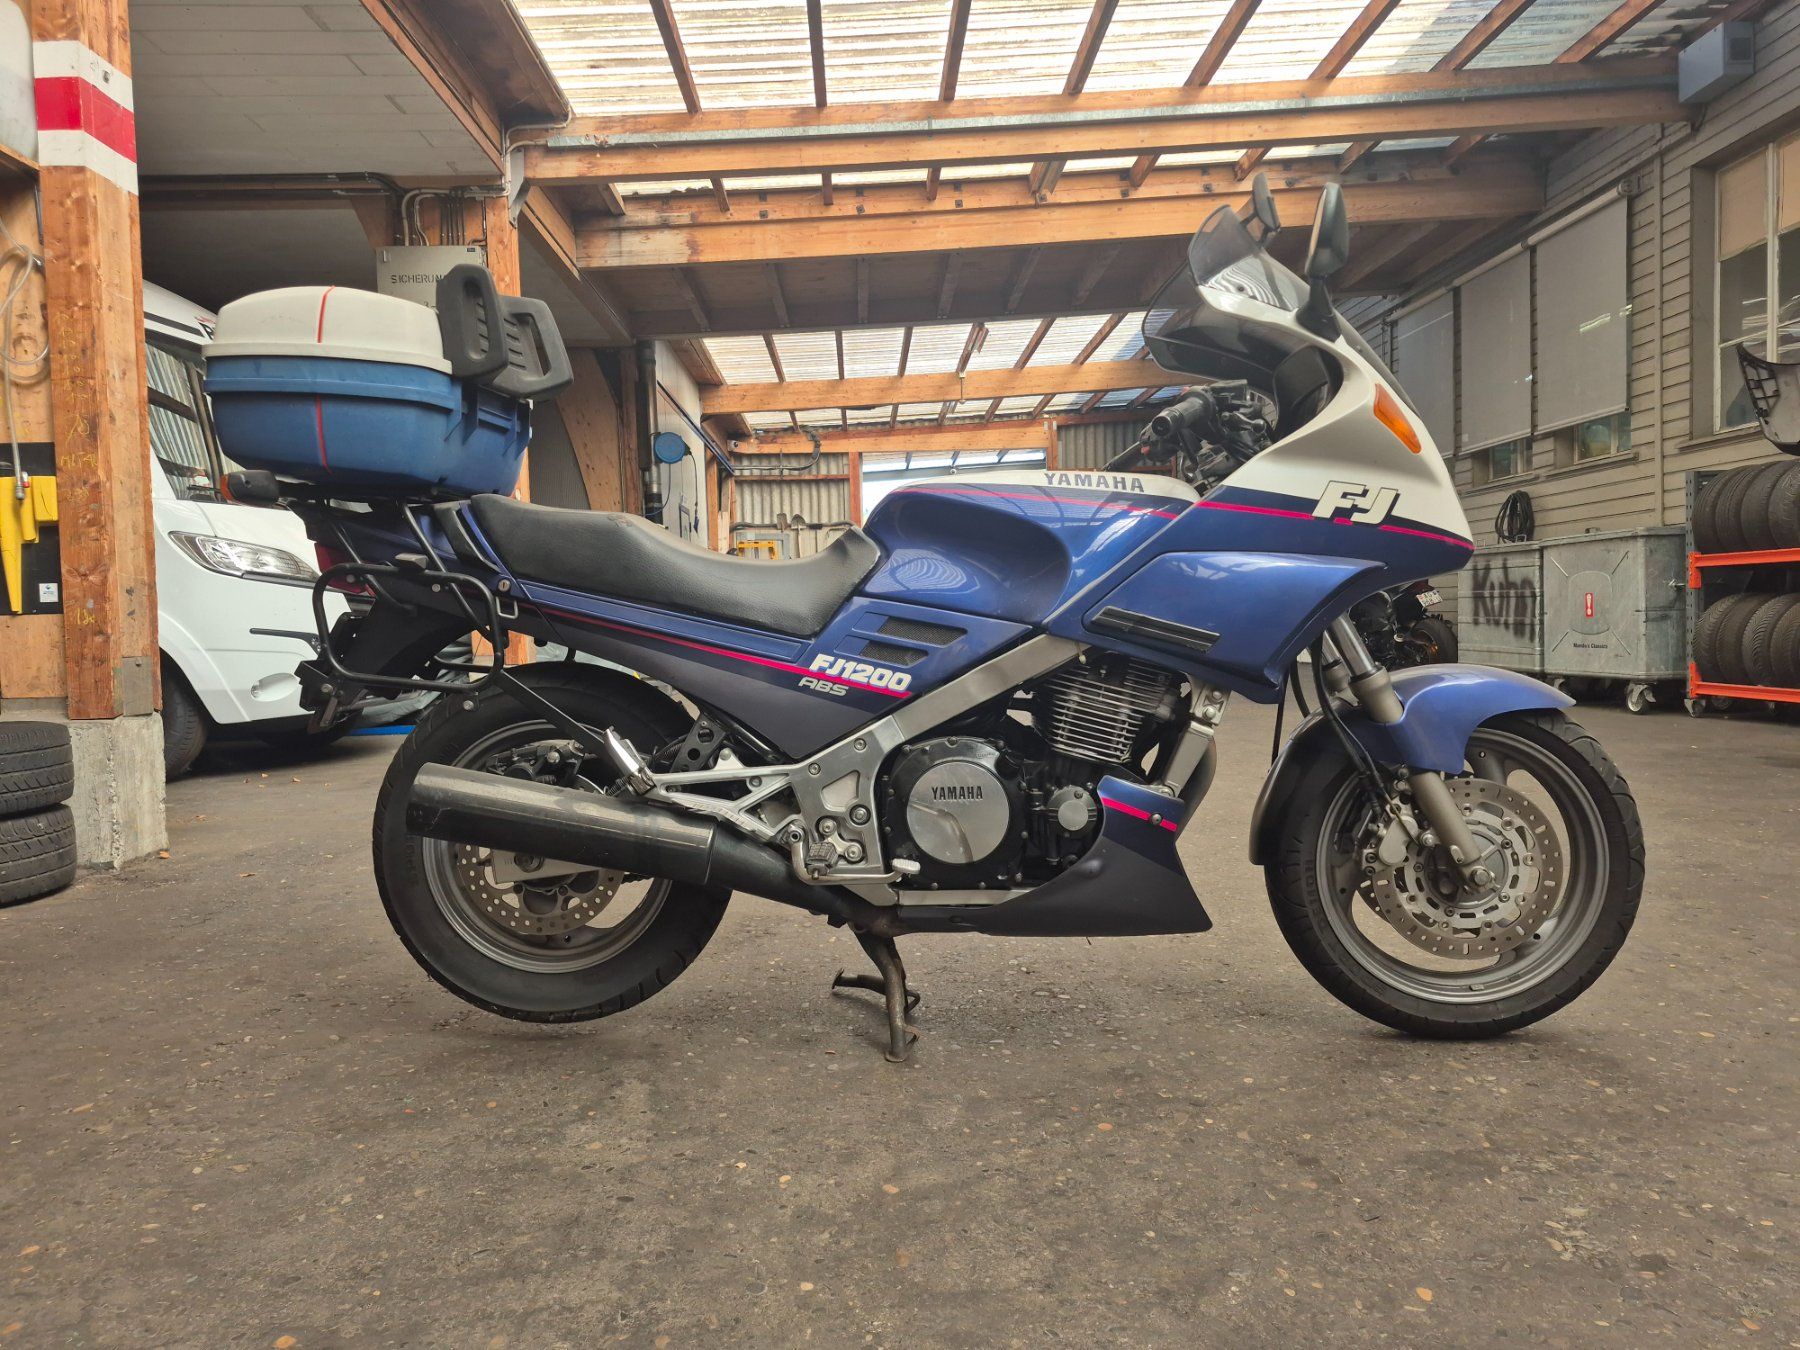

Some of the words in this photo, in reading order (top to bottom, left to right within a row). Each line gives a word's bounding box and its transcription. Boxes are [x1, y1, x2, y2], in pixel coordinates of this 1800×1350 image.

[1044, 473, 1144, 493] YAMAHA
[1311, 480, 1399, 525] FJ
[808, 653, 912, 692] FJ1200
[798, 676, 849, 697] ABS
[932, 786, 983, 800] YAMAHA
